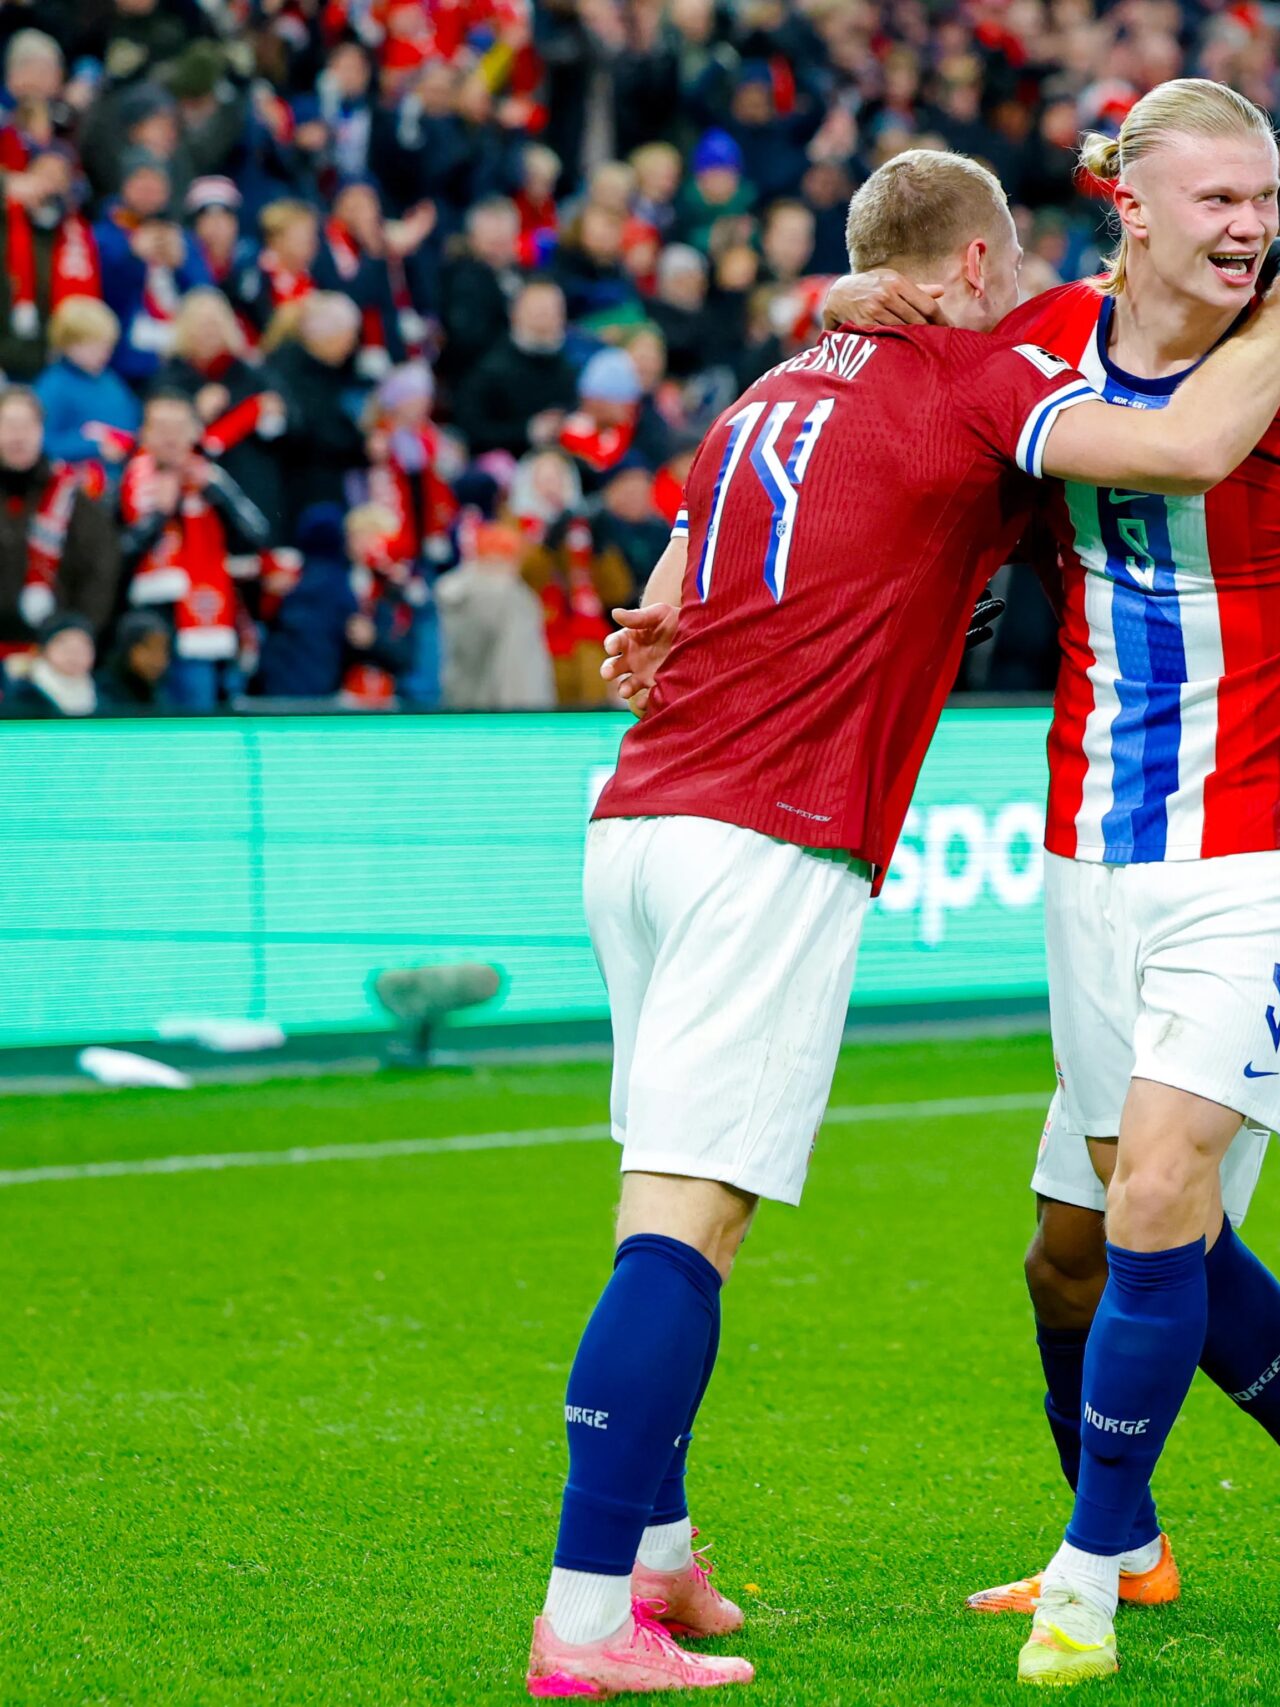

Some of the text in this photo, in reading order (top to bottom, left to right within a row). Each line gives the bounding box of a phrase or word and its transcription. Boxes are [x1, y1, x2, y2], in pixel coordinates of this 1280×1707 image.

[696, 397, 836, 605] 14
[1117, 518, 1155, 592] 9
[565, 1404, 609, 1430] ORGE
[1084, 1401, 1150, 1435] NORGE
